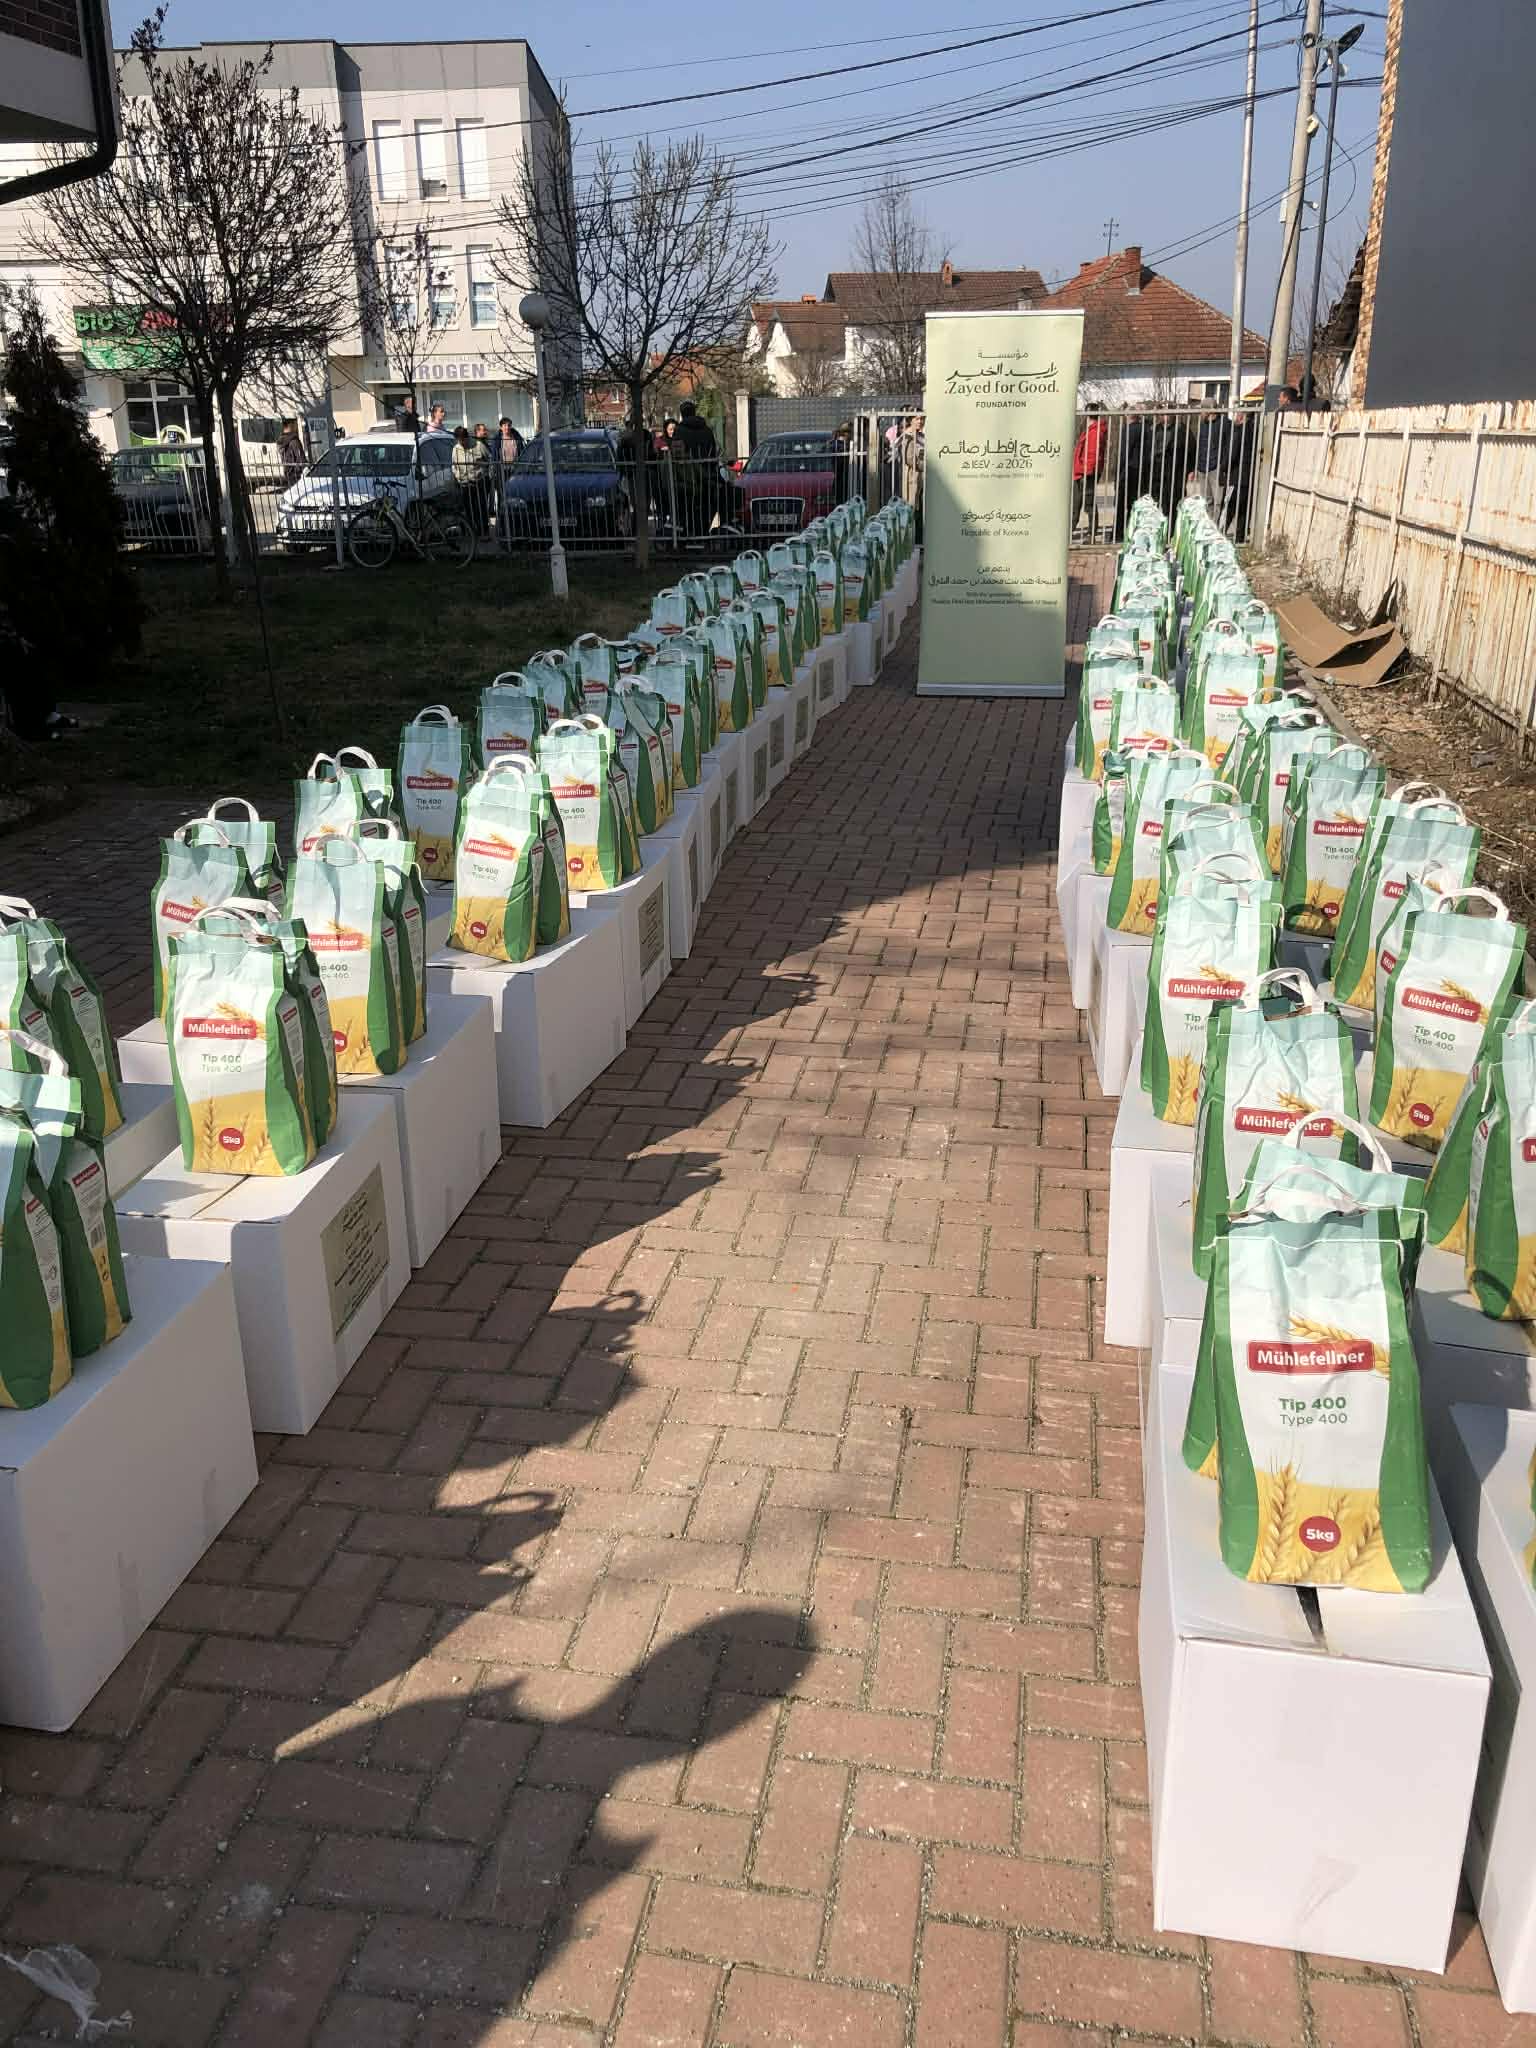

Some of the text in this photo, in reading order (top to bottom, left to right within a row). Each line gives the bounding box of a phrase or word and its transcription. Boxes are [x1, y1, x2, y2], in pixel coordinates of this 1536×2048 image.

[977, 349, 1028, 360] مؤسسة
[995, 380, 1015, 393] for
[938, 437, 1061, 459] برنامج إفطار صائم
[1173, 983, 1241, 997] Mühlefellner
[1407, 993, 1475, 1018] Mühlefellner
[1184, 1013, 1201, 1023] Tip
[1413, 1025, 1456, 1042] Tip 400
[1434, 1040, 1454, 1051] 400
[1242, 1114, 1327, 1131] Mühlefener
[1412, 1109, 1431, 1122] 5kg
[1257, 1349, 1366, 1367] Mühlefellner
[1279, 1397, 1347, 1412] Tip 400
[1279, 1413, 1348, 1426] Type 400
[1305, 1528, 1335, 1542] 5kg
